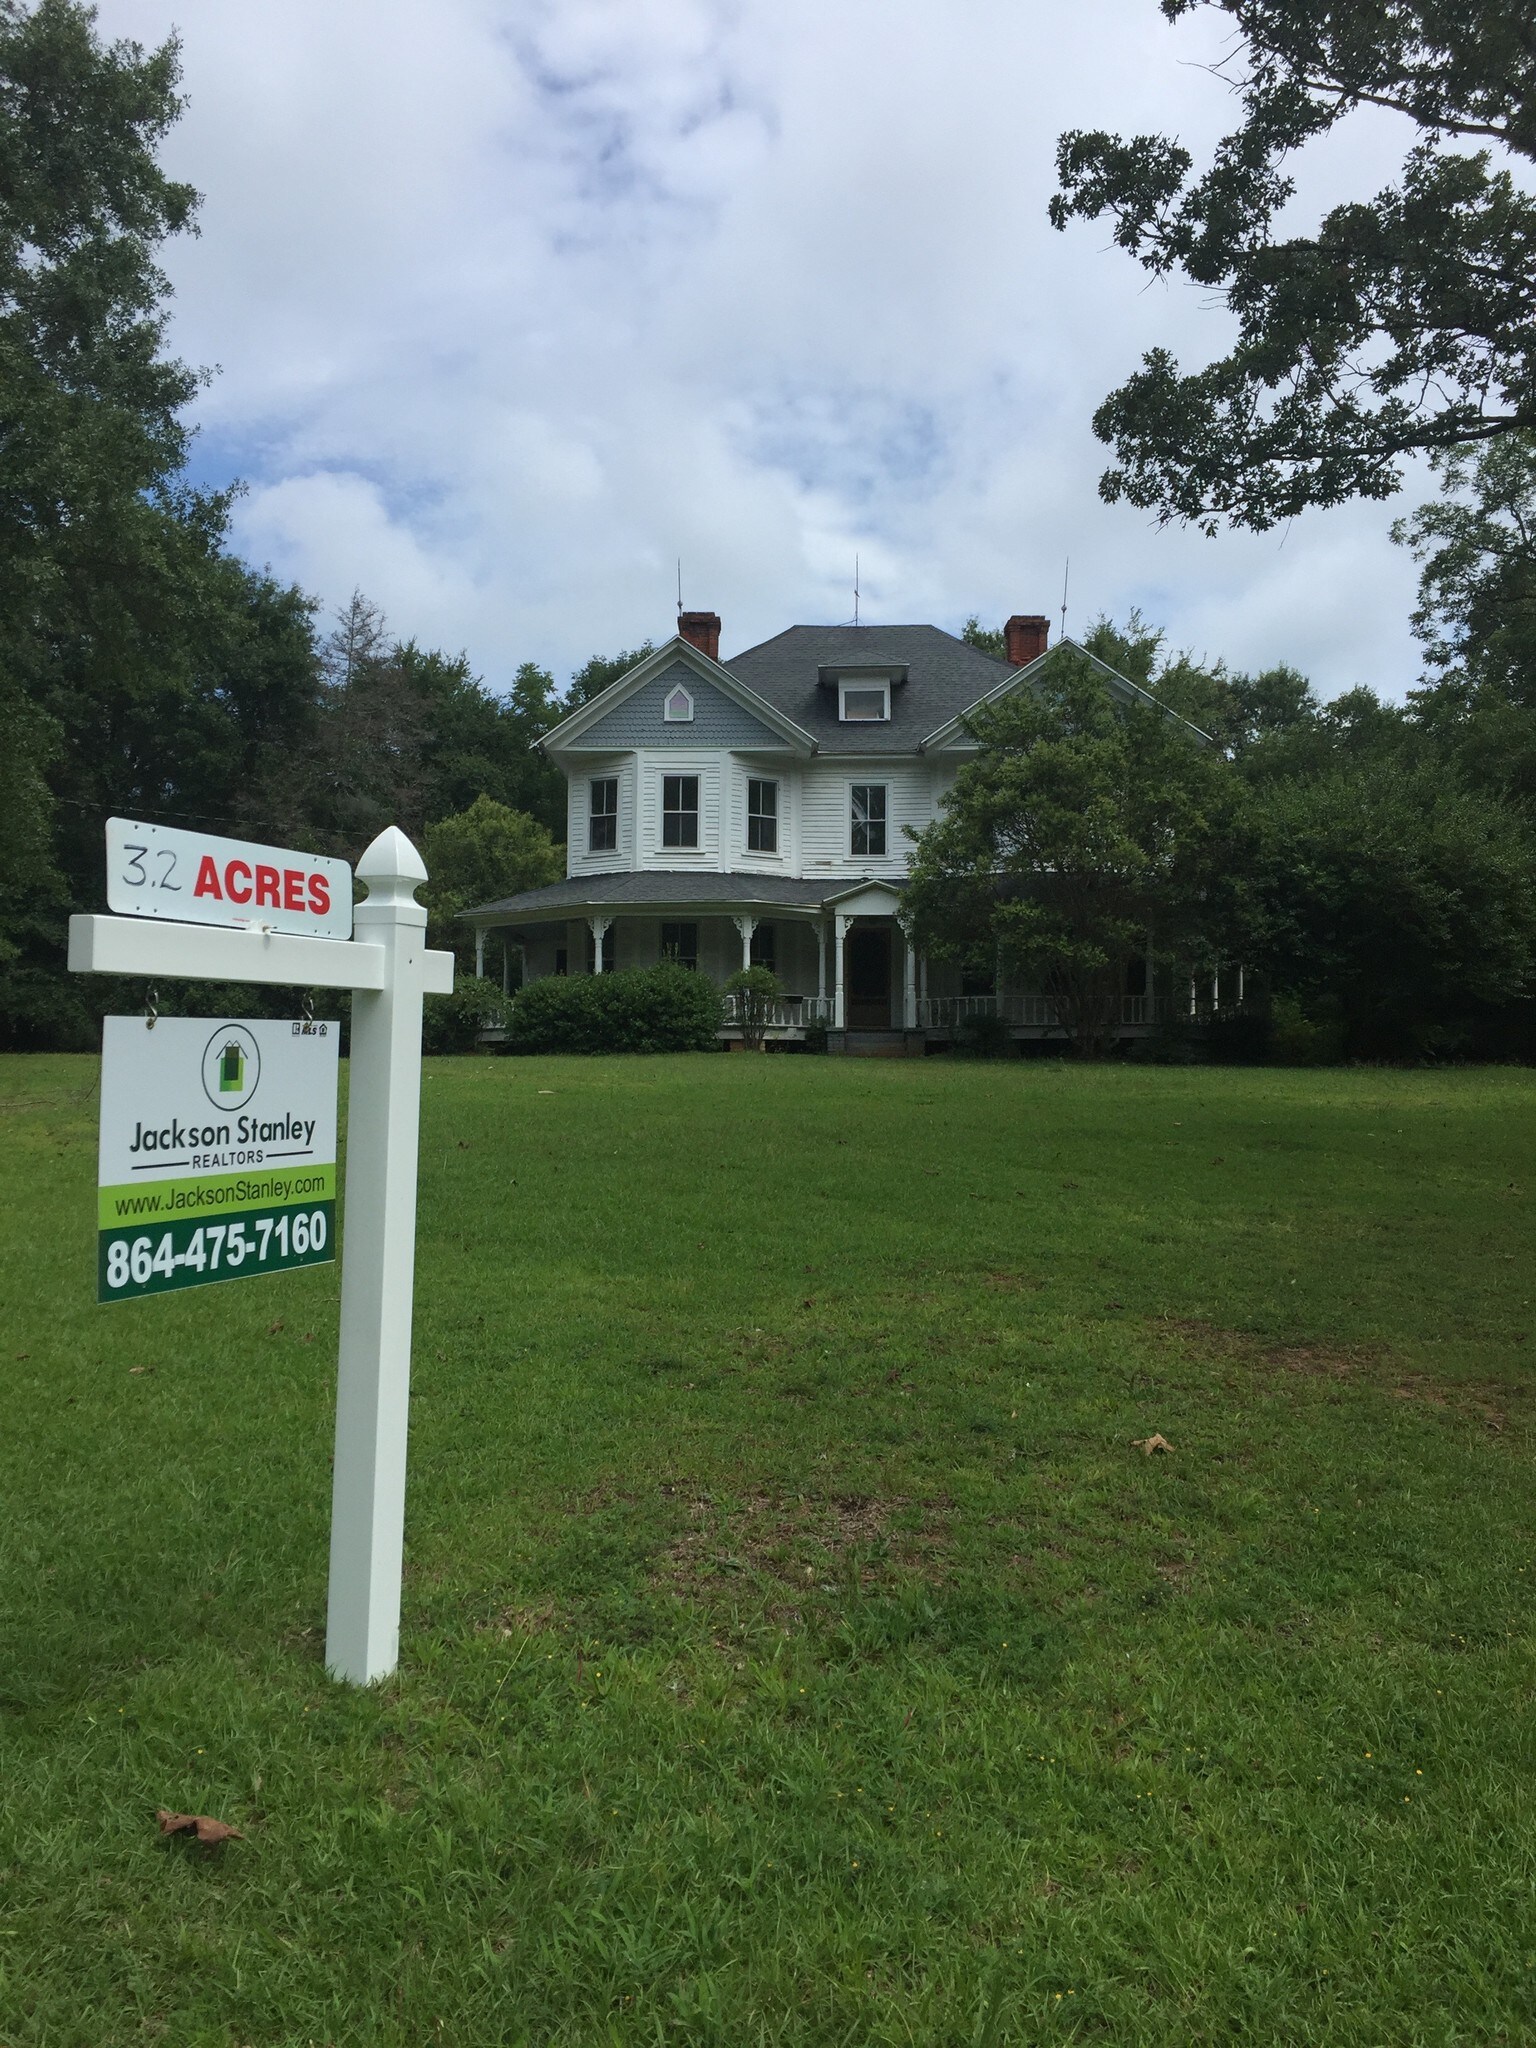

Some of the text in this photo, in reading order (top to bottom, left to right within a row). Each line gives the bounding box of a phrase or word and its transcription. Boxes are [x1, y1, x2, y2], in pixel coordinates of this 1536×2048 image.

[122, 844, 331, 915] 3.2 ACRES
[129, 1112, 316, 1153] Jackson Stanley
[192, 1149, 263, 1169] REALTORS
[115, 1176, 325, 1216] www.JacksonStanley.com
[106, 1210, 327, 1289] 864-475-7160
